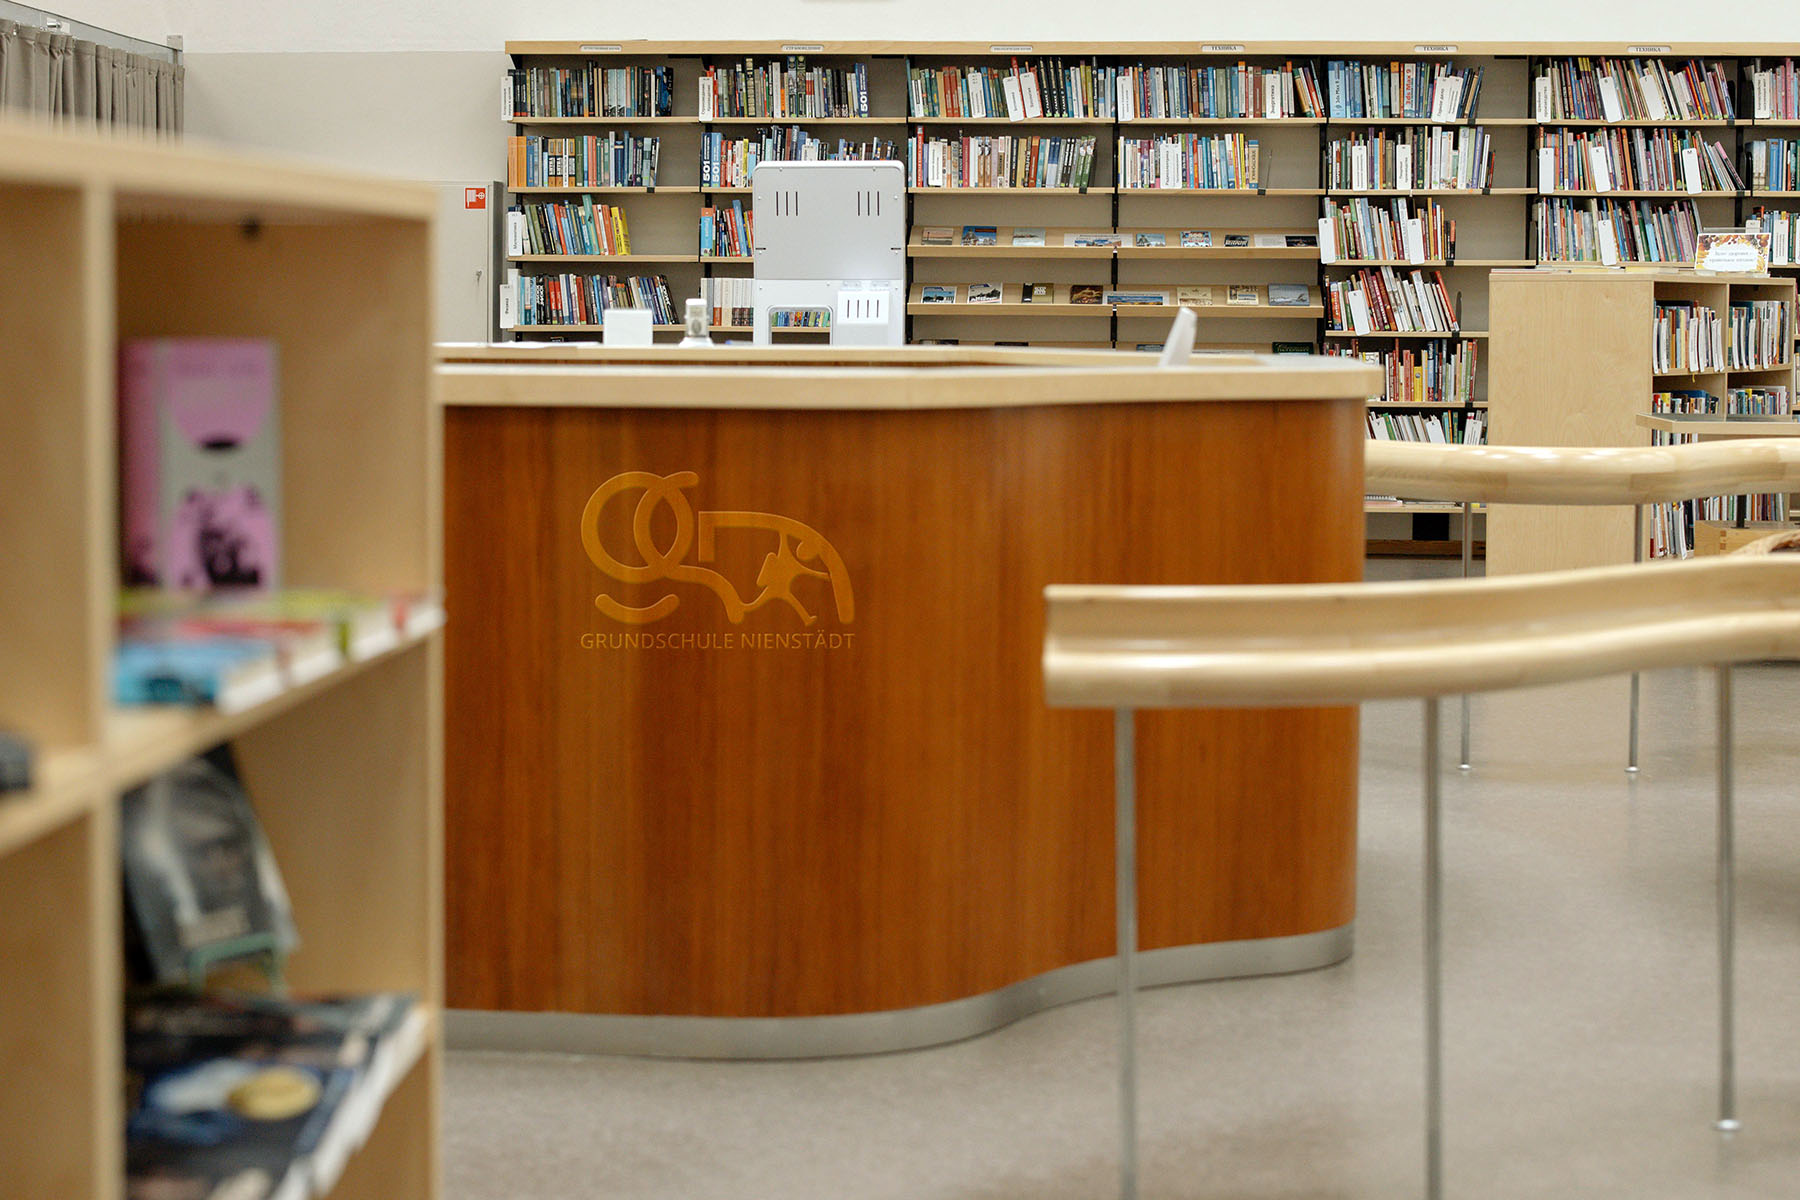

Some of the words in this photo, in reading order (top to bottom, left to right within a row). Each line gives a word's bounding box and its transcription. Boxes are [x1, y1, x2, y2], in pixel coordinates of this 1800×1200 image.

[859, 91, 868, 112] 501
[703, 160, 711, 181] 501
[712, 162, 720, 182] 501
[580, 633, 733, 649] GRUNDSCHULE
[741, 629, 855, 649] NIENSTÄDT
